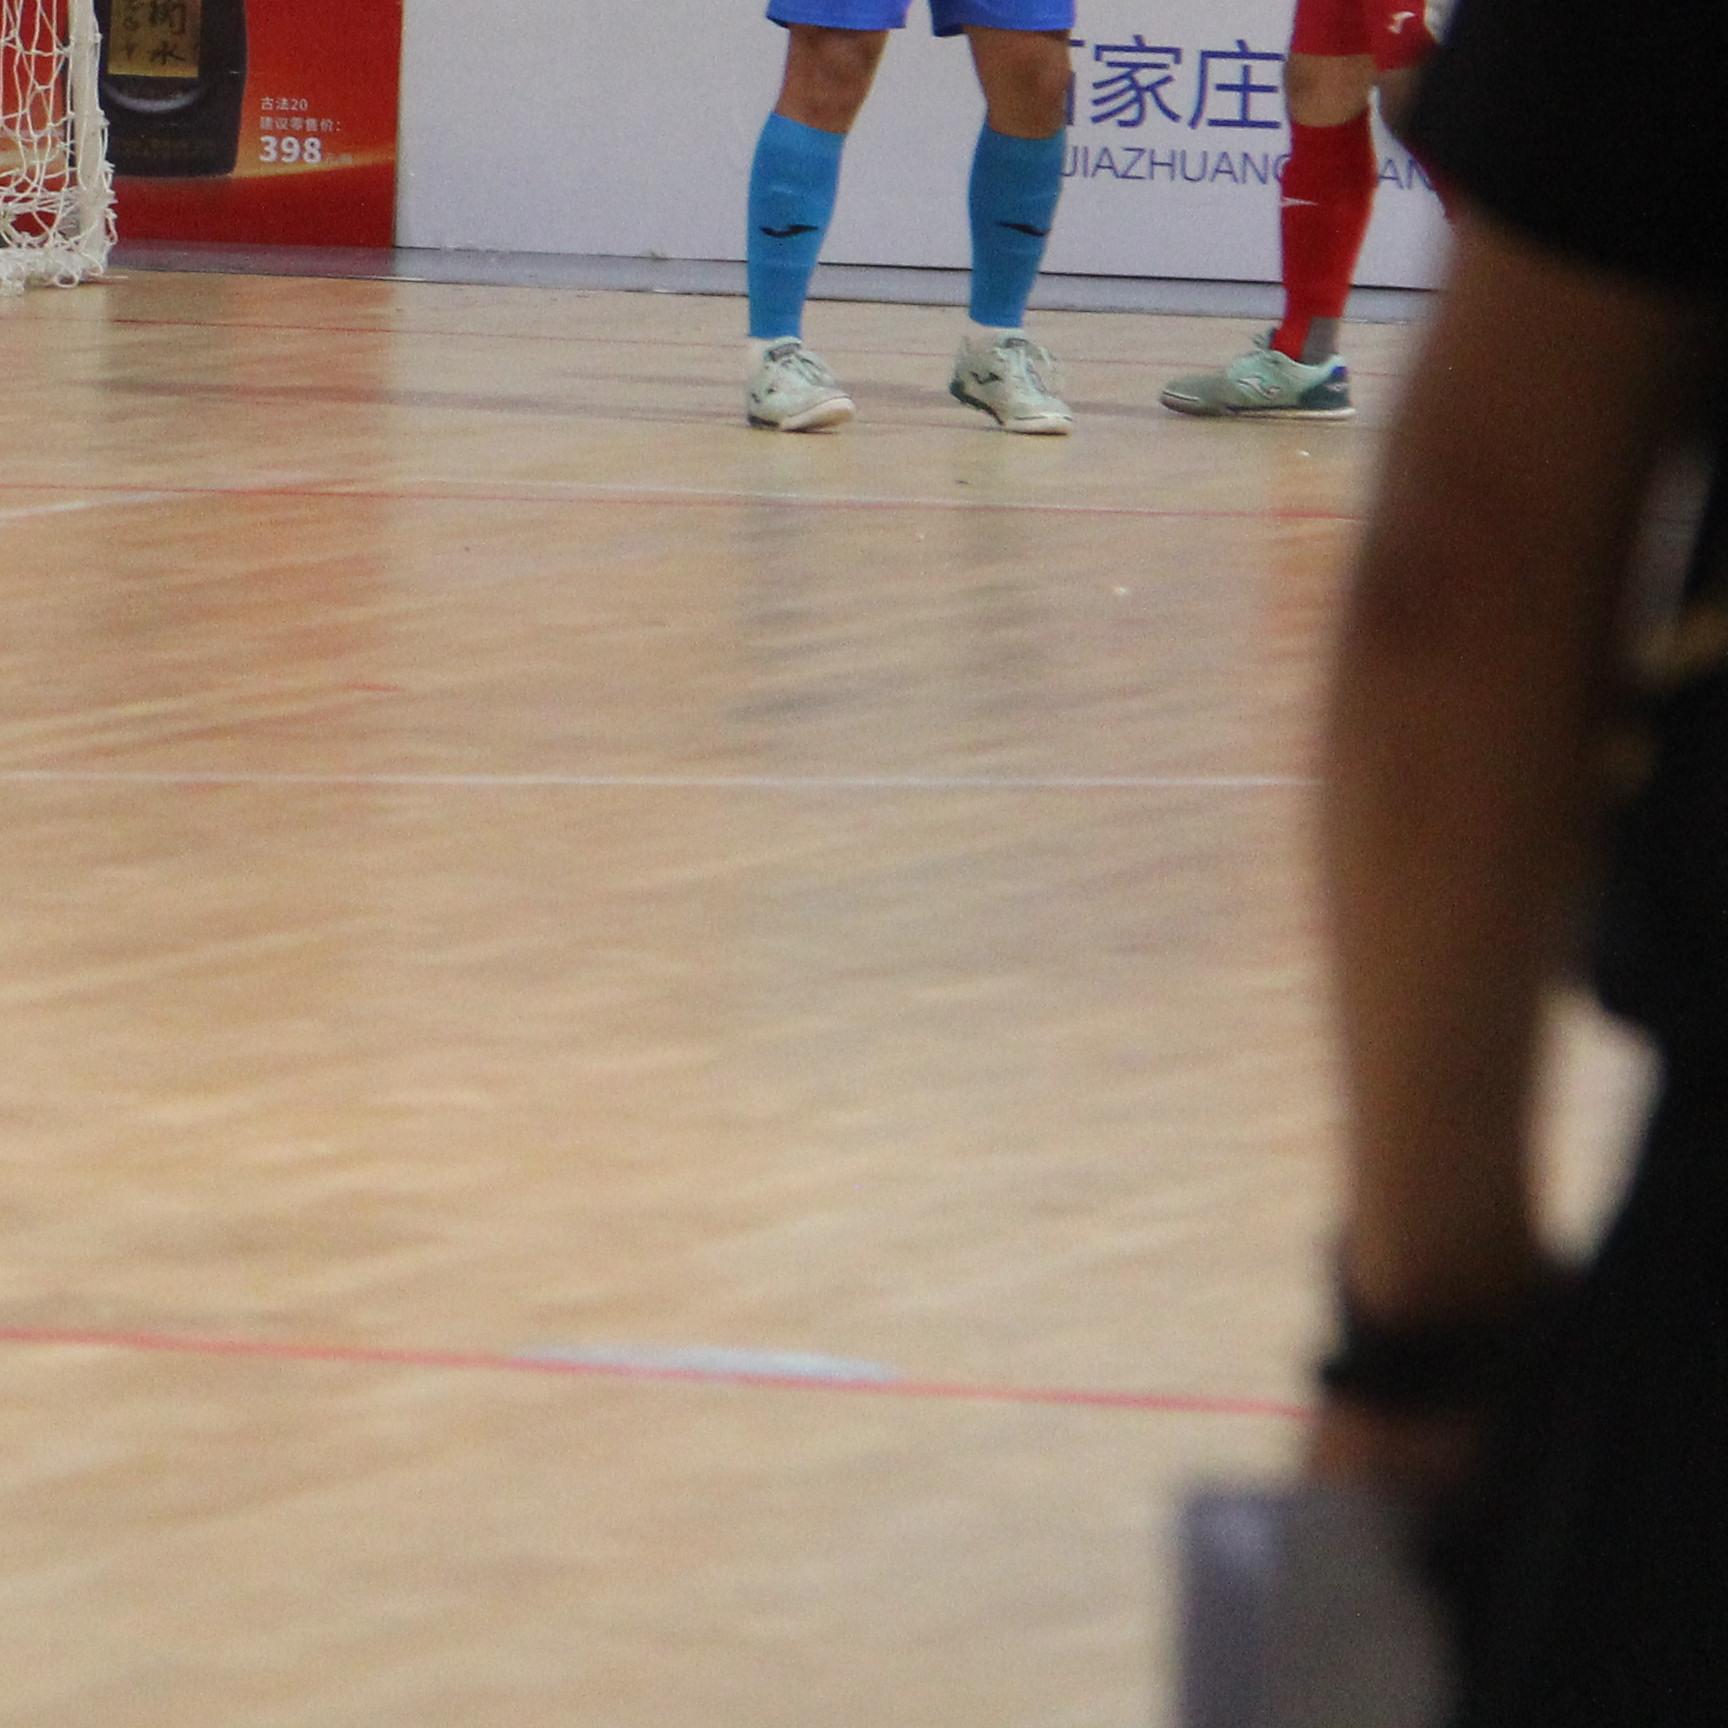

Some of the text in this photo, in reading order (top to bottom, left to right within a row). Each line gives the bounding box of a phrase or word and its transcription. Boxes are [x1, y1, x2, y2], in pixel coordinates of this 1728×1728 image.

[1067, 34, 1286, 130] 家庄
[260, 96, 309, 112] 古法20
[259, 135, 322, 164] 398
